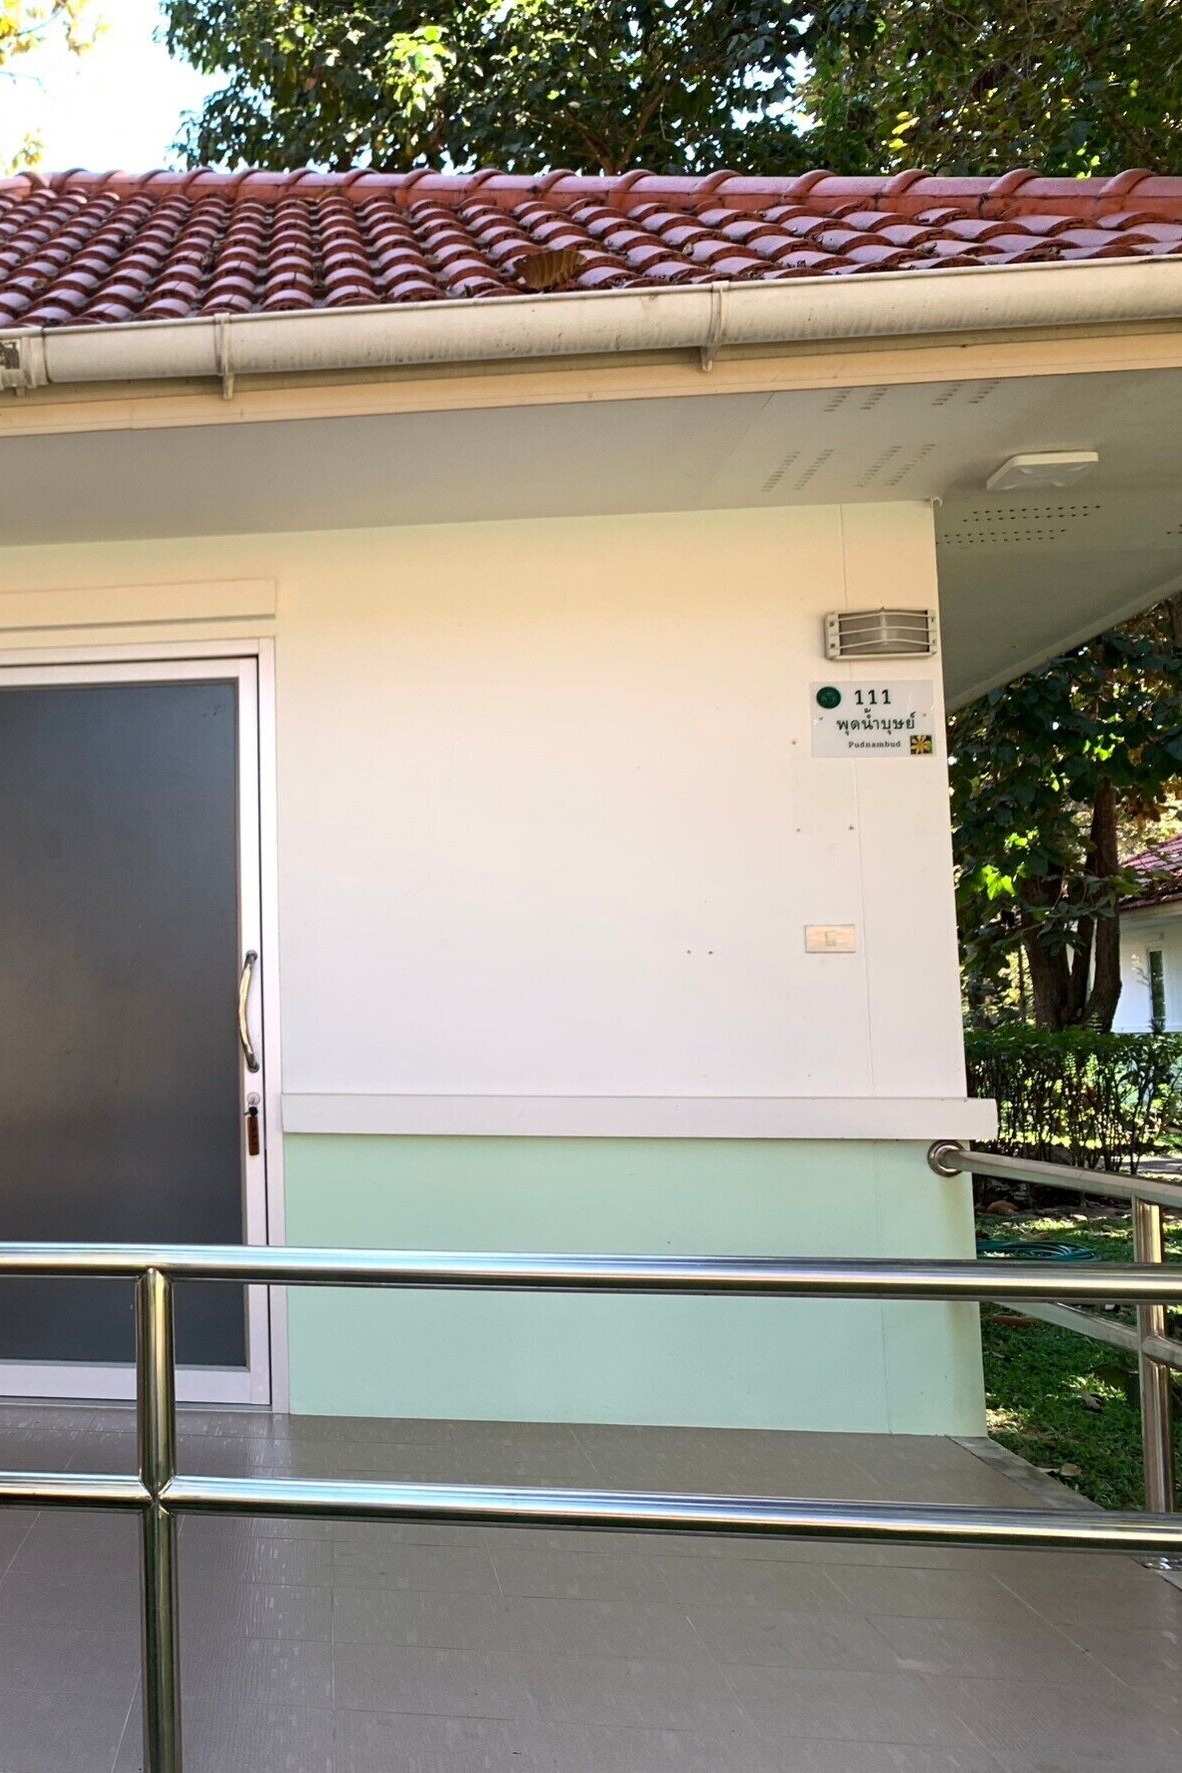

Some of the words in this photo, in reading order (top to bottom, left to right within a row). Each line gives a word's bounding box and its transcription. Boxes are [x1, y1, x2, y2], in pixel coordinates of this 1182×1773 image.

[854, 689, 892, 705] 111
[836, 707, 916, 736] พุดน้ำบุษย์
[848, 740, 901, 748] Pudnambud
